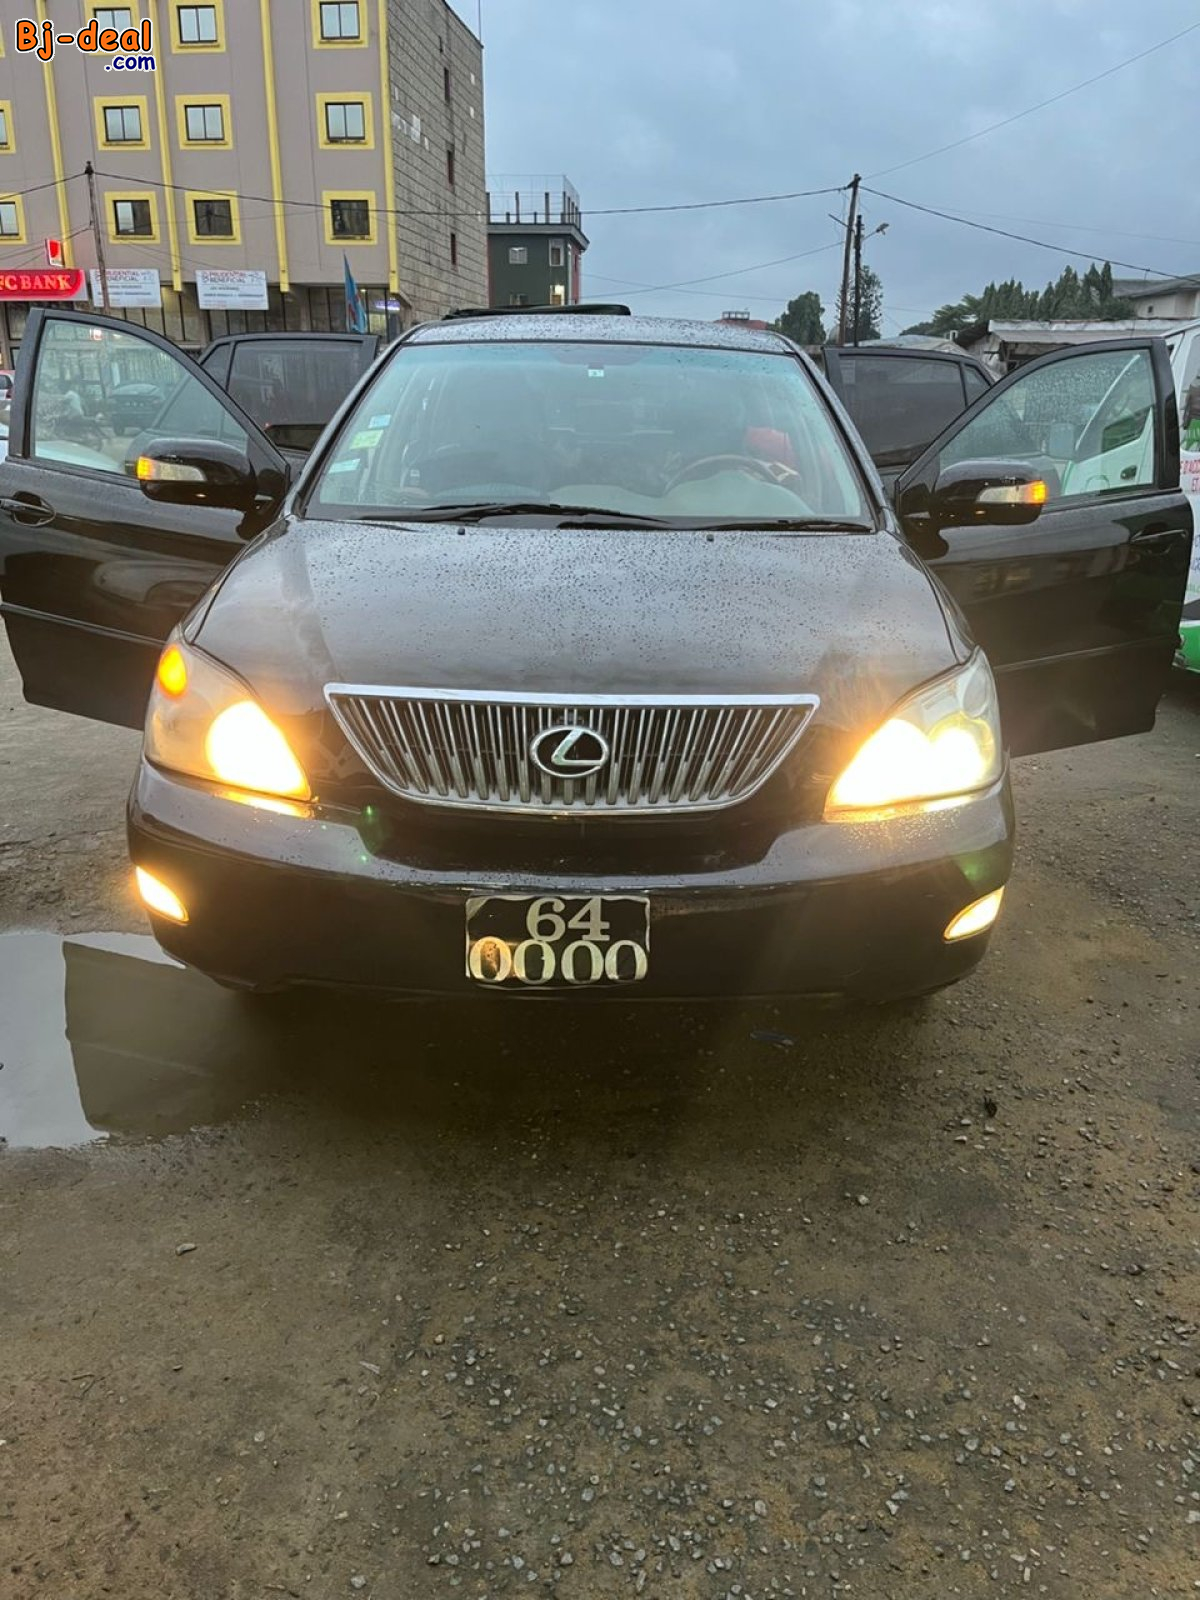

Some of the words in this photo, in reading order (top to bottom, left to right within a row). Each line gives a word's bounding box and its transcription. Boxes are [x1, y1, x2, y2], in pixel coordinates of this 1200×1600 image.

[19, 274, 72, 291] BANK
[526, 897, 610, 942] 64
[469, 936, 648, 984] 0000
